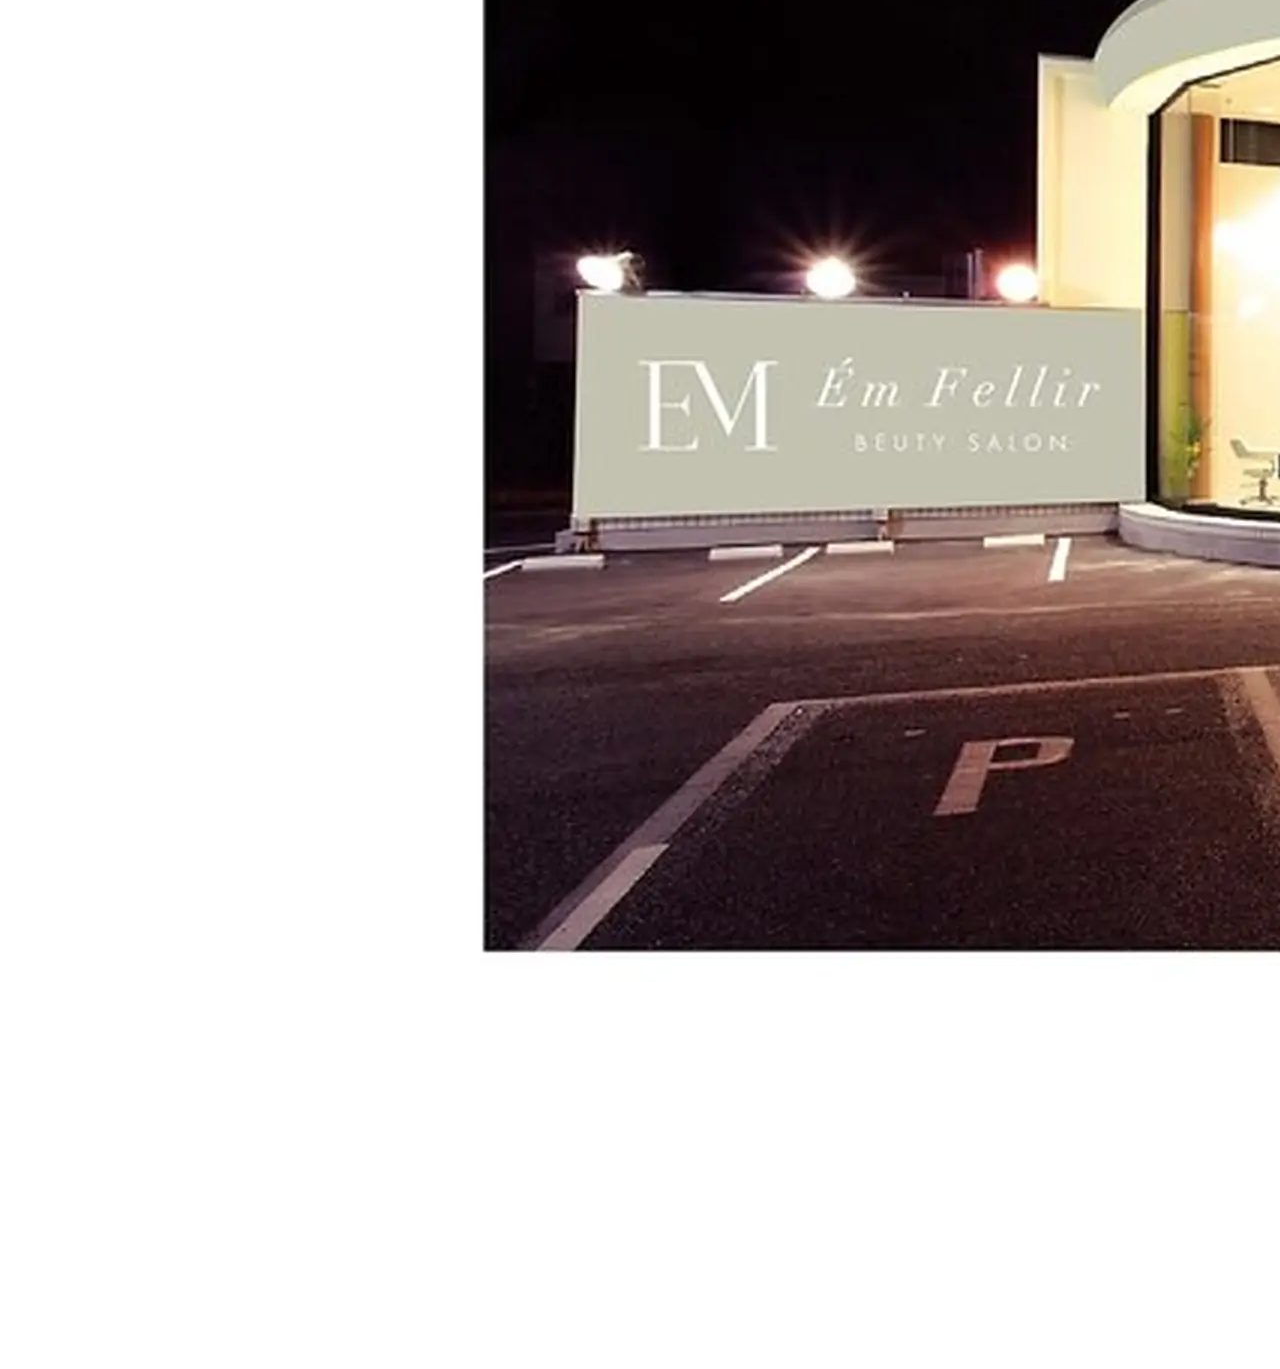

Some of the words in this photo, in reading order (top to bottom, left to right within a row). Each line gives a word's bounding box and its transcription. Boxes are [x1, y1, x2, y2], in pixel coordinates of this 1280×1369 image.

[638, 359, 779, 453] EM
[815, 357, 900, 408] Ém
[924, 365, 1102, 409] Fellir
[853, 432, 945, 453] BEUTY
[968, 432, 1071, 453] SALON
[934, 736, 1074, 816] P
